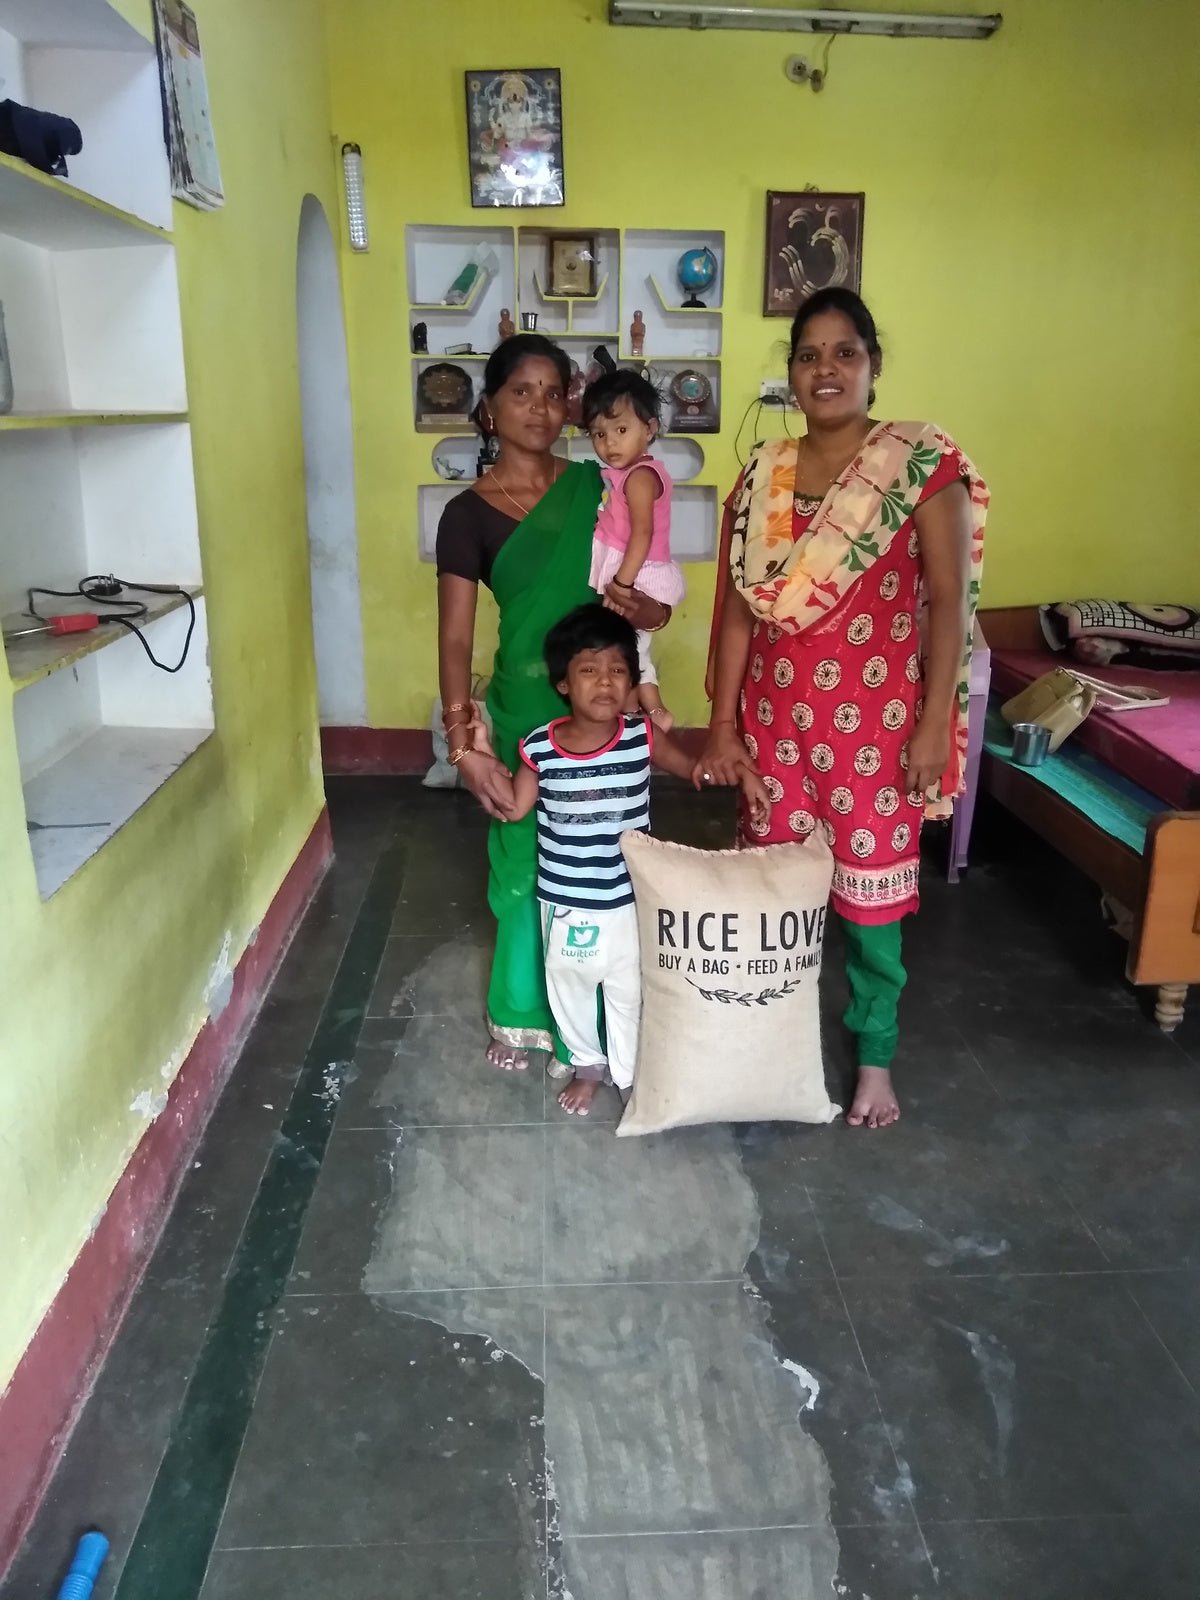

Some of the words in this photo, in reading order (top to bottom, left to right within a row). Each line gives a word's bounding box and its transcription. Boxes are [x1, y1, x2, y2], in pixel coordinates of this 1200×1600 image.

[658, 908, 738, 952] RICE
[760, 905, 826, 952] LOVE
[561, 947, 600, 958] twitter
[658, 953, 681, 970] BUY
[687, 957, 696, 973] A
[702, 958, 729, 975] BAG
[747, 958, 778, 975] FEED
[783, 957, 791, 973] A
